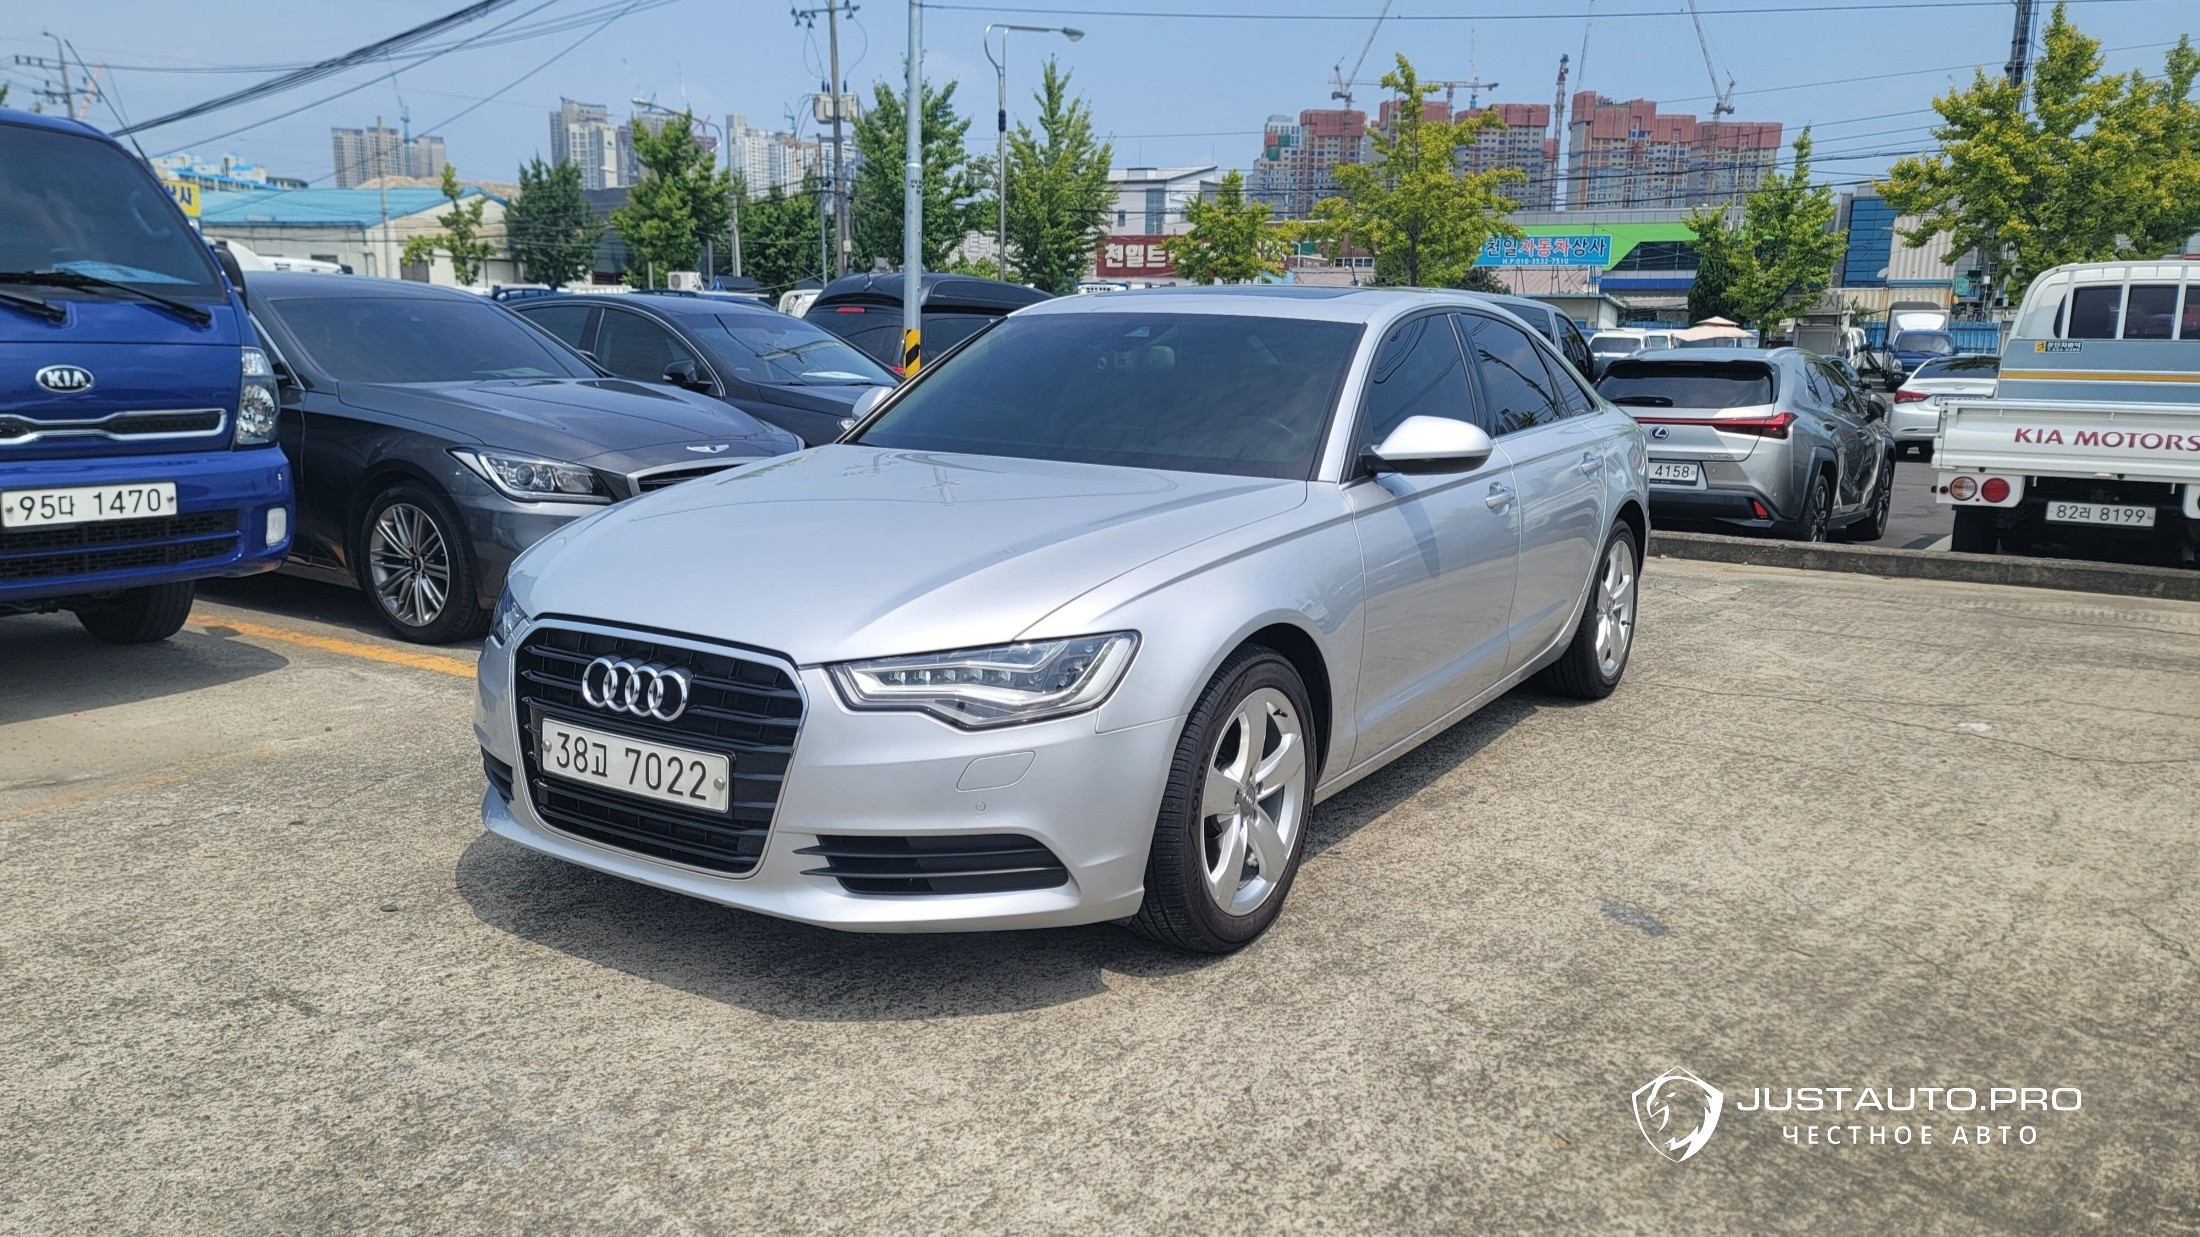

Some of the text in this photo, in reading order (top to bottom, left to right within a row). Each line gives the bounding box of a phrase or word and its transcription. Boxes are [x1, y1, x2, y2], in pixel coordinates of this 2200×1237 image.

[1105, 243, 1177, 268] 천일트
[1485, 238, 1606, 257] 천일자동차상사
[46, 370, 87, 387] KIA
[2014, 428, 2200, 451] KIA MOTORS
[1654, 465, 1690, 478] 4158
[19, 488, 161, 521] 95다 1470
[2100, 507, 2146, 523] 8199
[556, 731, 707, 801] 38고 7022
[1191, 751, 1209, 827] SOLUS
